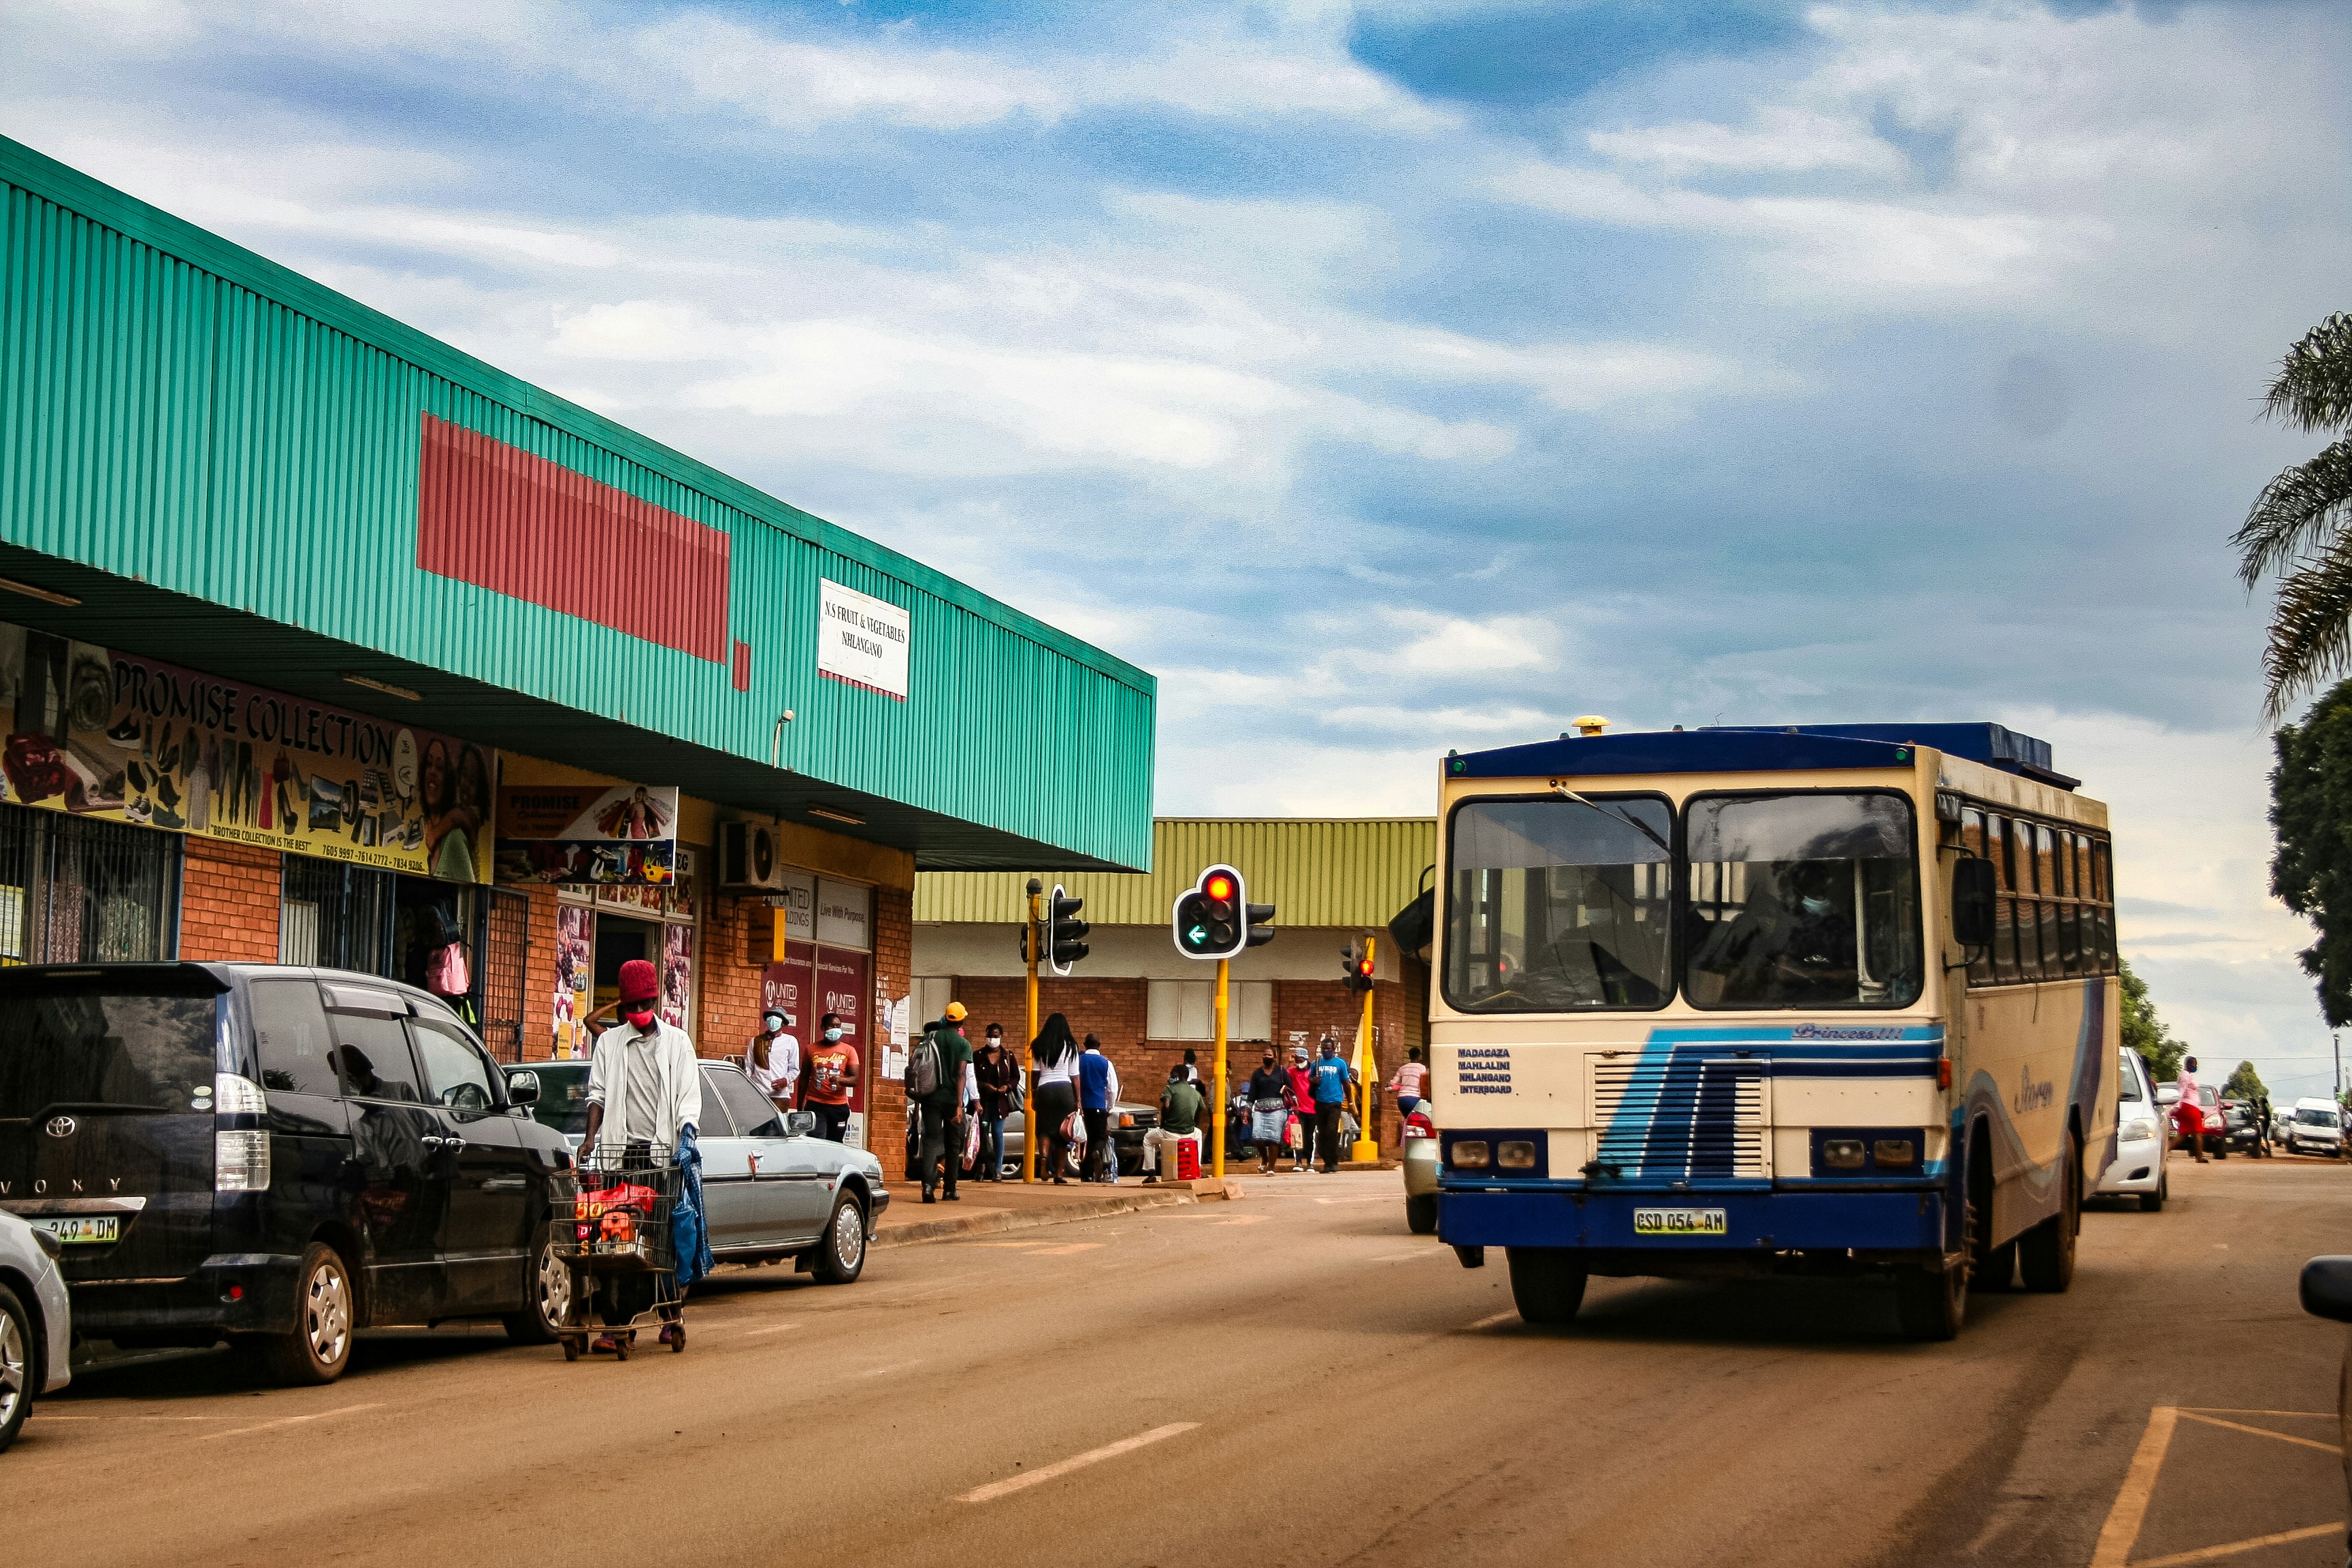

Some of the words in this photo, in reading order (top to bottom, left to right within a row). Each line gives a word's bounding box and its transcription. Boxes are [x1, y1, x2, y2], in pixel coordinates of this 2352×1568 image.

[838, 606, 859, 626] FRUIT
[860, 615, 865, 628] &
[867, 617, 905, 644] VEGETABLES
[842, 631, 883, 658] NHLANGANO
[114, 659, 238, 734] PROMISE
[246, 693, 394, 768] COLLECTION
[511, 795, 580, 809] PROMISE
[242, 829, 275, 846] COLLECTION
[276, 836, 282, 846] IS
[283, 838, 294, 849] THE
[323, 844, 338, 857] 7605
[338, 847, 354, 859] 9997
[373, 853, 388, 866] 2772
[393, 857, 407, 870] 7834
[786, 911, 809, 927] LDINGS
[820, 903, 831, 917] Live
[832, 905, 843, 919] With
[776, 983, 798, 1000] UNITED
[836, 993, 856, 1009] UNITED
[1458, 1061, 1510, 1071] MAHLALINI
[1459, 1073, 1512, 1083] NHLANGANO
[96, 1219, 116, 1239] DM
[1637, 1212, 1662, 1230] GSD
[1667, 1213, 1695, 1229] 054
[1704, 1213, 1723, 1230] AM
